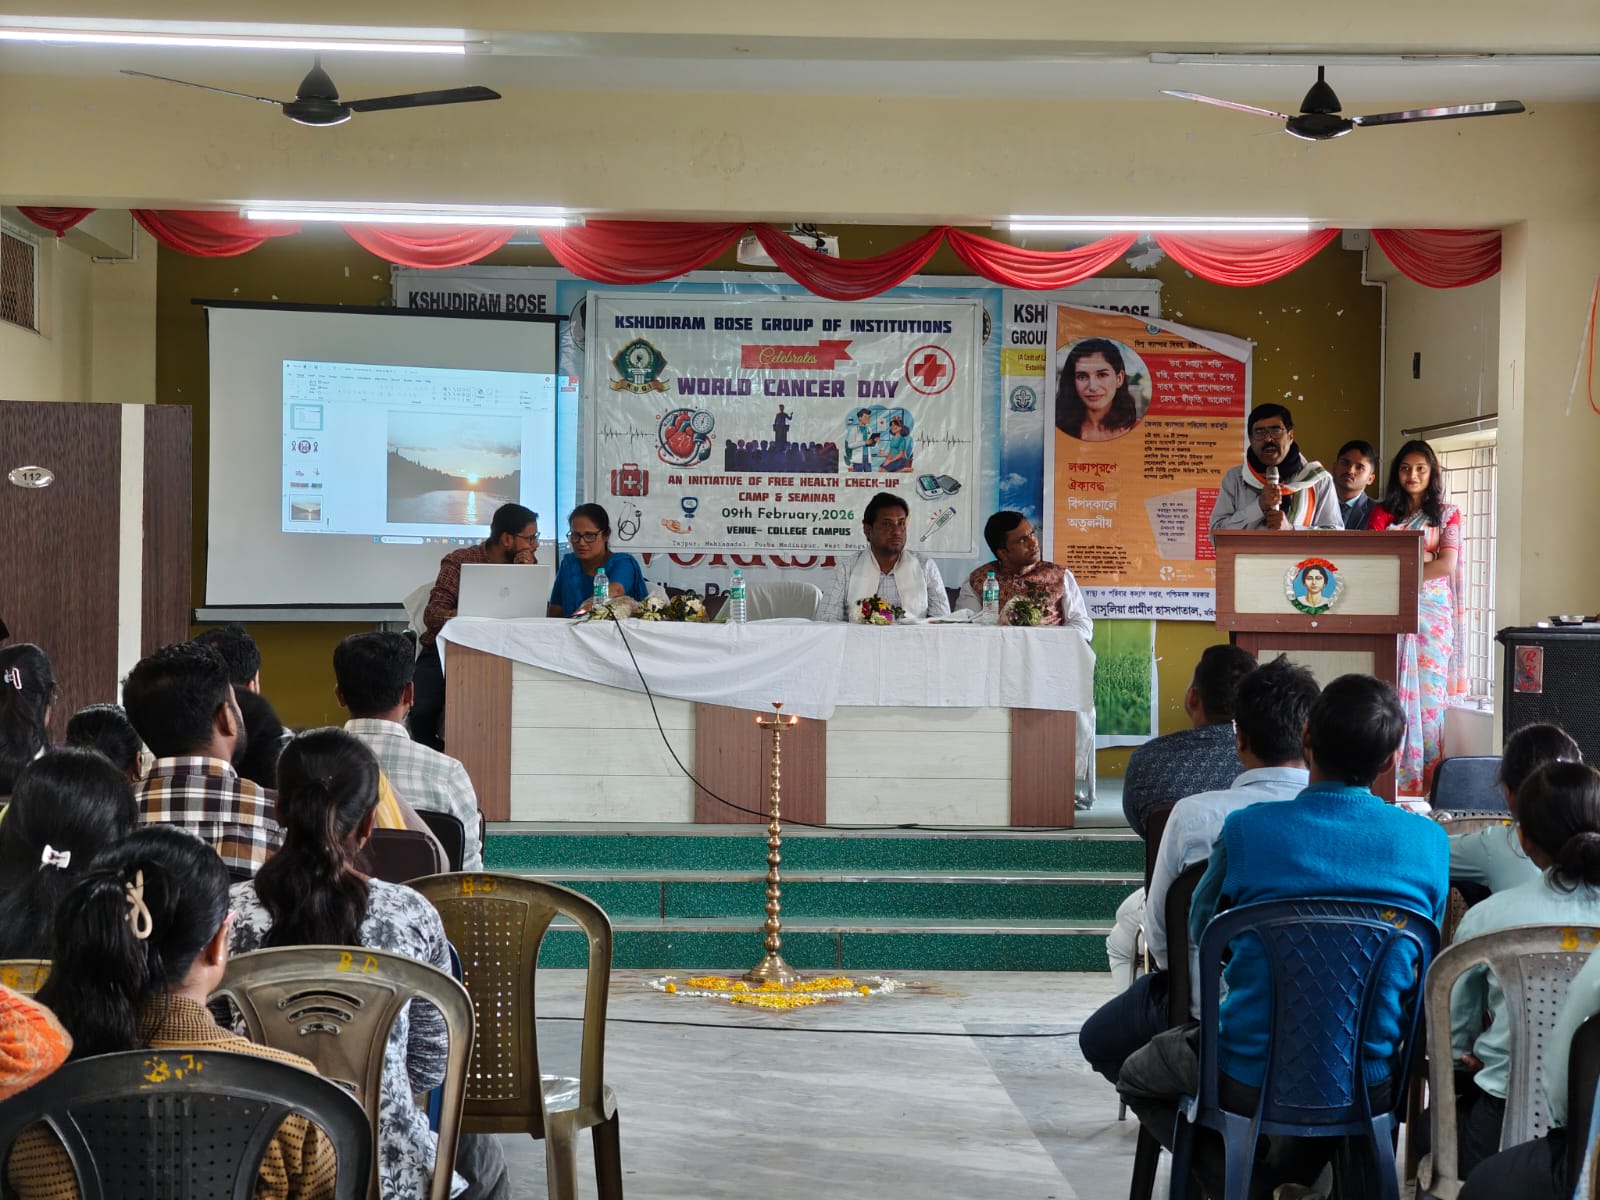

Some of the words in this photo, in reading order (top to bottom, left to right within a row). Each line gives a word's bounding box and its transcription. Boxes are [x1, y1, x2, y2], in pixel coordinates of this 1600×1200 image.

[408, 291, 501, 313] KSHUDIRAM
[505, 294, 547, 313] BOSE
[1014, 304, 1048, 323] KSH
[615, 315, 706, 330] KSHUDIRAM
[714, 317, 753, 331] BOSE
[761, 318, 814, 332] GROUP
[822, 319, 842, 332] OF
[850, 319, 952, 334] INSTITUTIONS
[1011, 330, 1047, 345] GROU
[758, 346, 818, 366] Celebrates
[677, 377, 751, 396] WORLD
[764, 378, 845, 398] CANCER
[857, 380, 899, 399] DAY
[22, 472, 42, 481] 112
[668, 475, 683, 485] AN
[688, 475, 743, 486] INITIATIVE
[748, 476, 762, 486] OF
[767, 476, 795, 487] FREE
[800, 477, 840, 488] HEALTH
[845, 478, 900, 488] CHECK-UP
[738, 492, 770, 502] CAMP
[775, 492, 783, 502] &
[788, 492, 836, 503] SEMINAR
[1067, 496, 1118, 512] বিপদকালে
[721, 506, 752, 519] 09th
[726, 525, 763, 535] VENUE-
[767, 526, 808, 536] COLLEGE
[812, 527, 851, 536] CAMPUS
[1067, 515, 1113, 532] অতুলনীয়
[1090, 601, 1126, 617] বাসুলিয়া
[1128, 601, 1153, 615] গ্রামীণ
[1155, 605, 1202, 618] হাসপাতাল,
